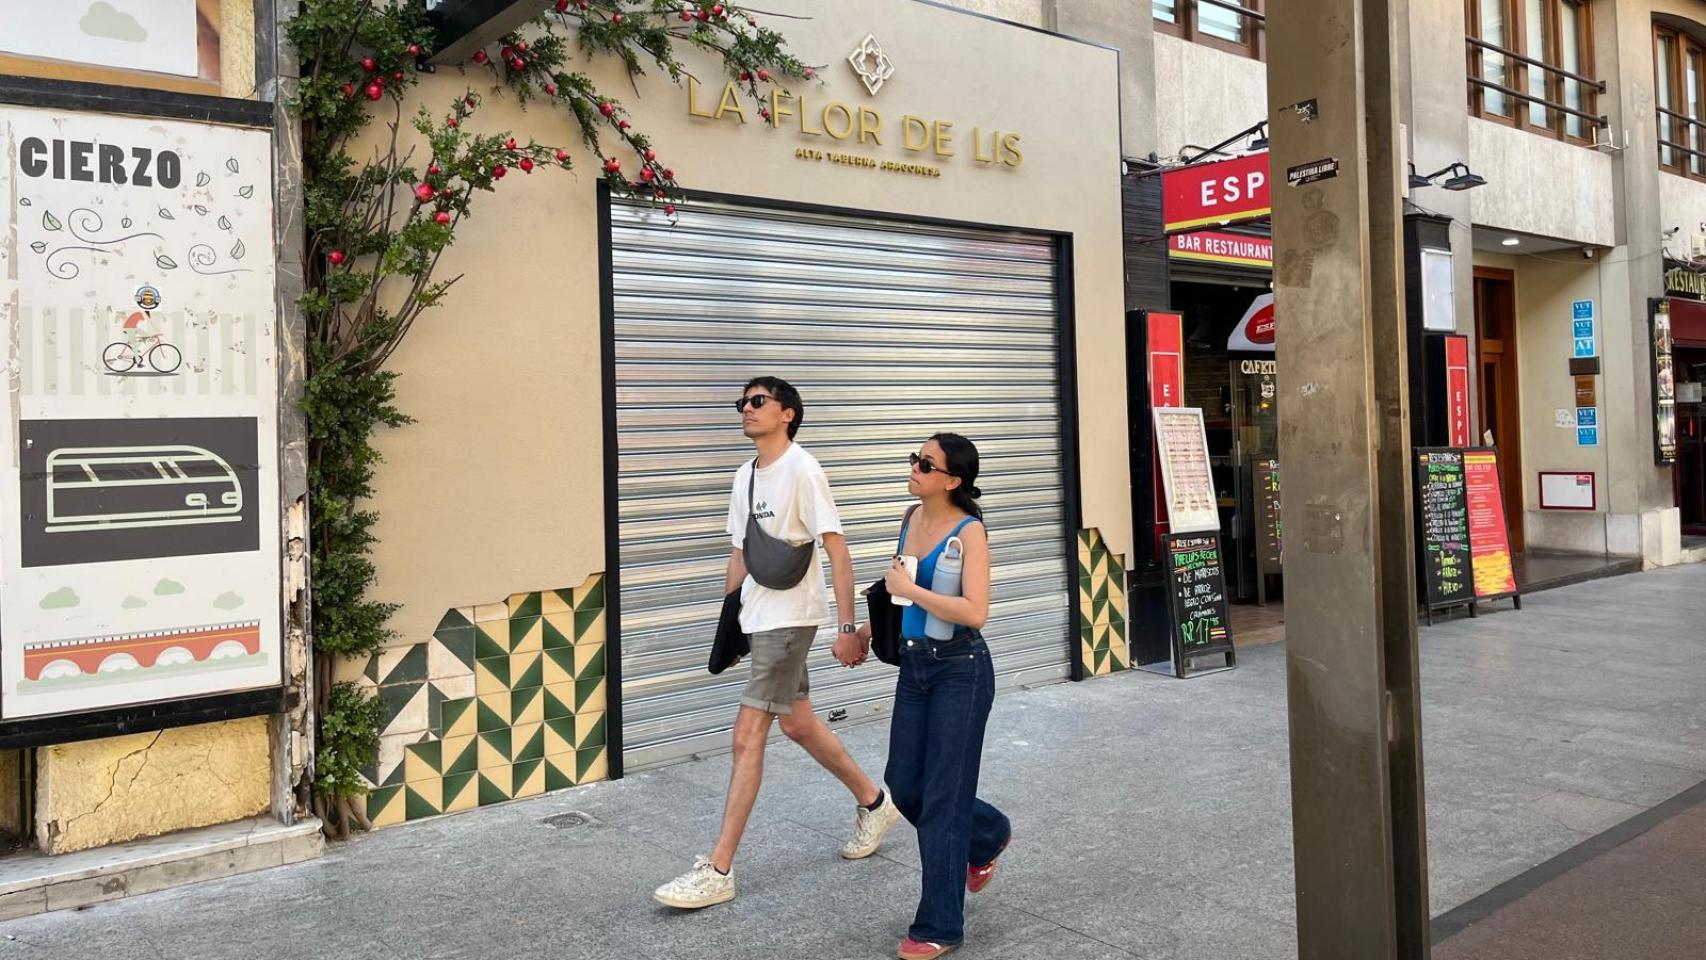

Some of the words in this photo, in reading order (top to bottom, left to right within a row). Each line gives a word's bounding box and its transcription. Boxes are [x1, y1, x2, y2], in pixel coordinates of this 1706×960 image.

[688, 76, 746, 124] LA
[771, 89, 883, 145] FLOR
[903, 114, 955, 157] DE
[973, 126, 1024, 168] LIS
[19, 136, 182, 190] CIERZO
[795, 148, 823, 161] ALTA
[826, 152, 877, 168] TABERNA
[1200, 171, 1265, 207] ESP
[1177, 234, 1201, 251] BAR
